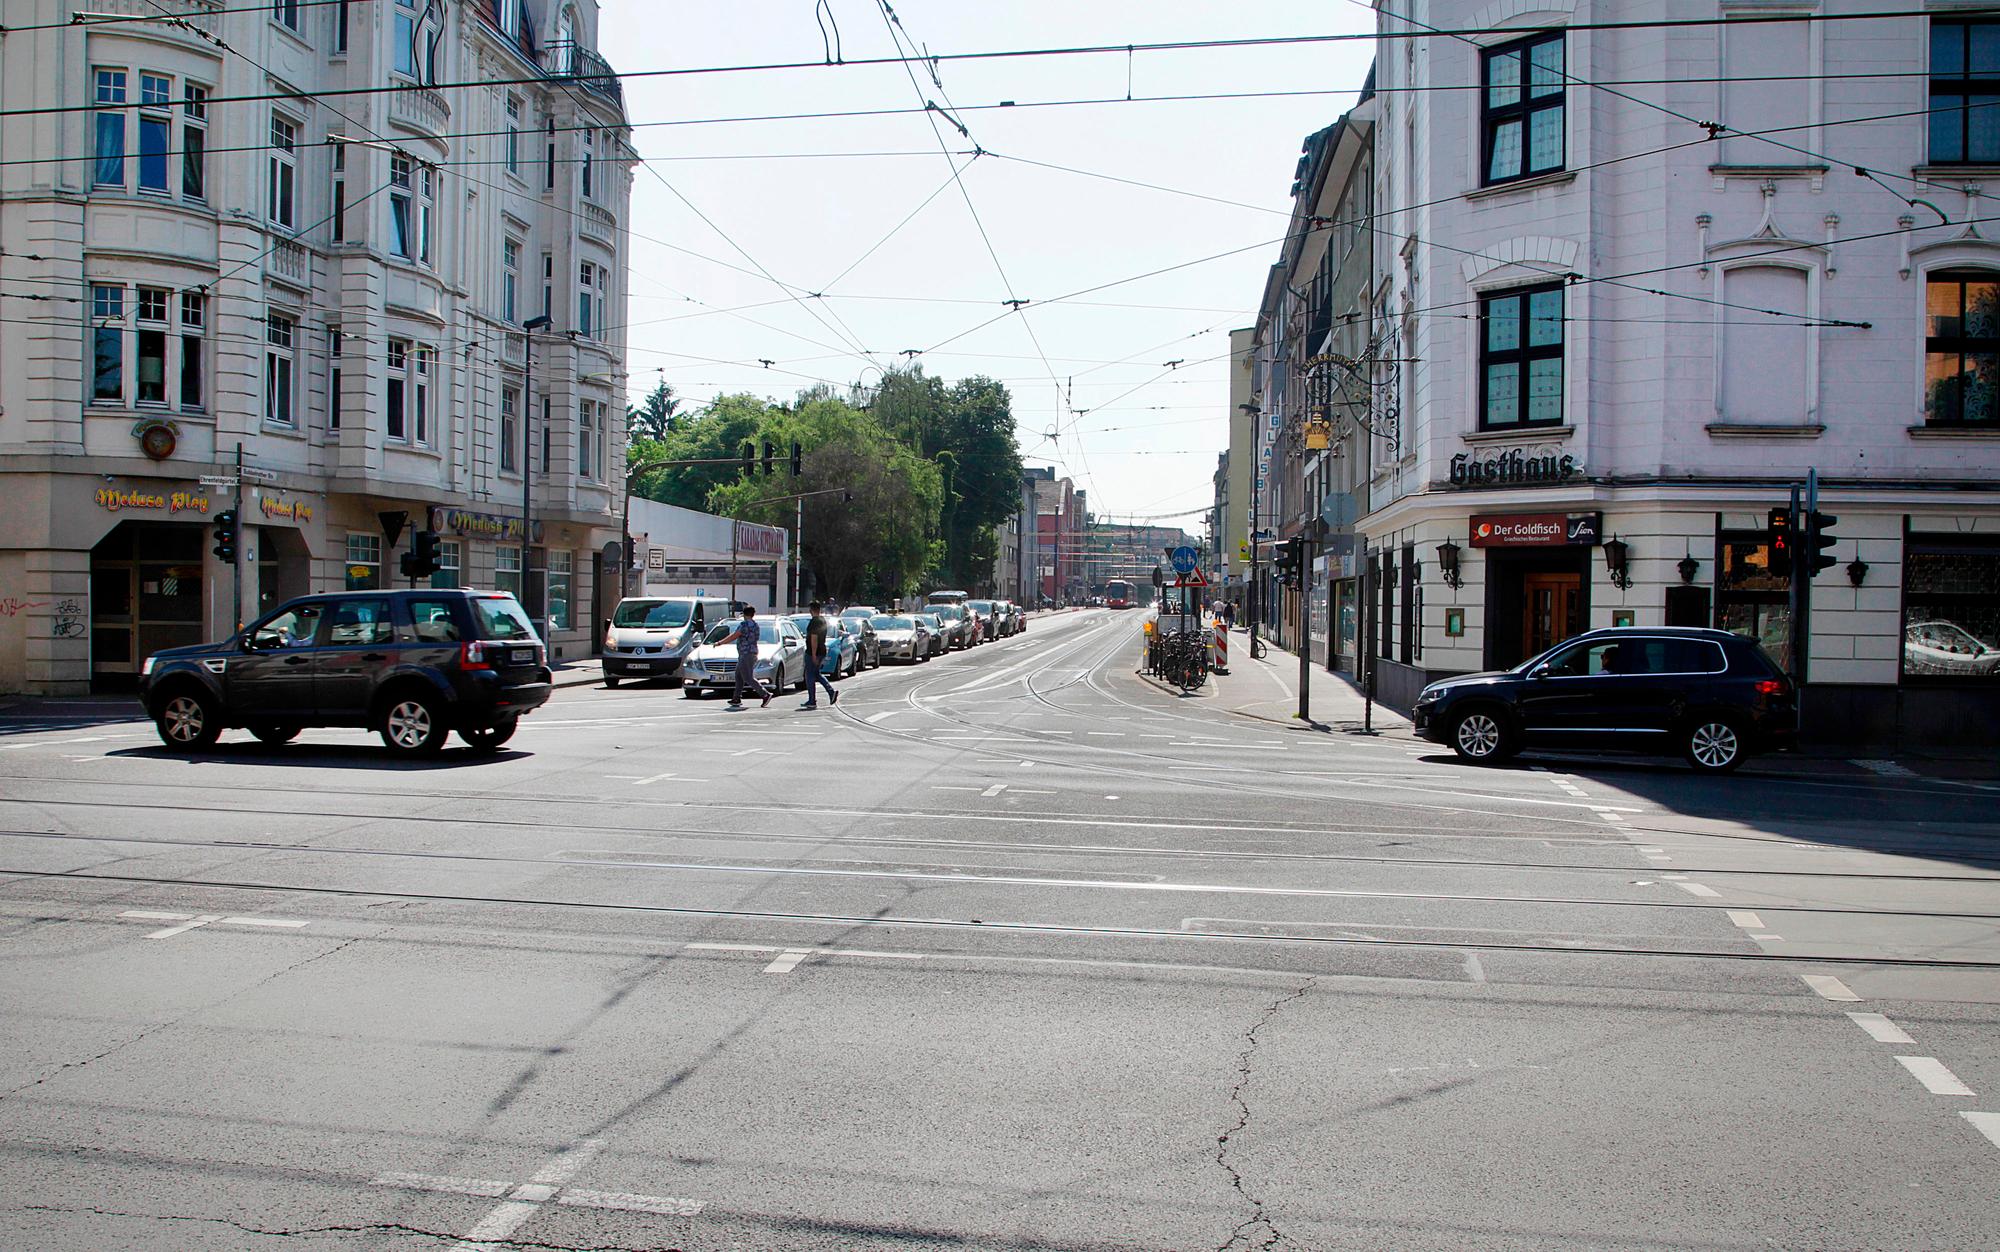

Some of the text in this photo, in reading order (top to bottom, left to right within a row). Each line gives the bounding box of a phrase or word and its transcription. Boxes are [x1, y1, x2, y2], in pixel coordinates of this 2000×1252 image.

[1450, 448, 1573, 485] Gasthaus
[95, 489, 209, 514] Medusa Play
[261, 495, 292, 519] Medusa
[1494, 523, 1560, 535] Der Goldfisch
